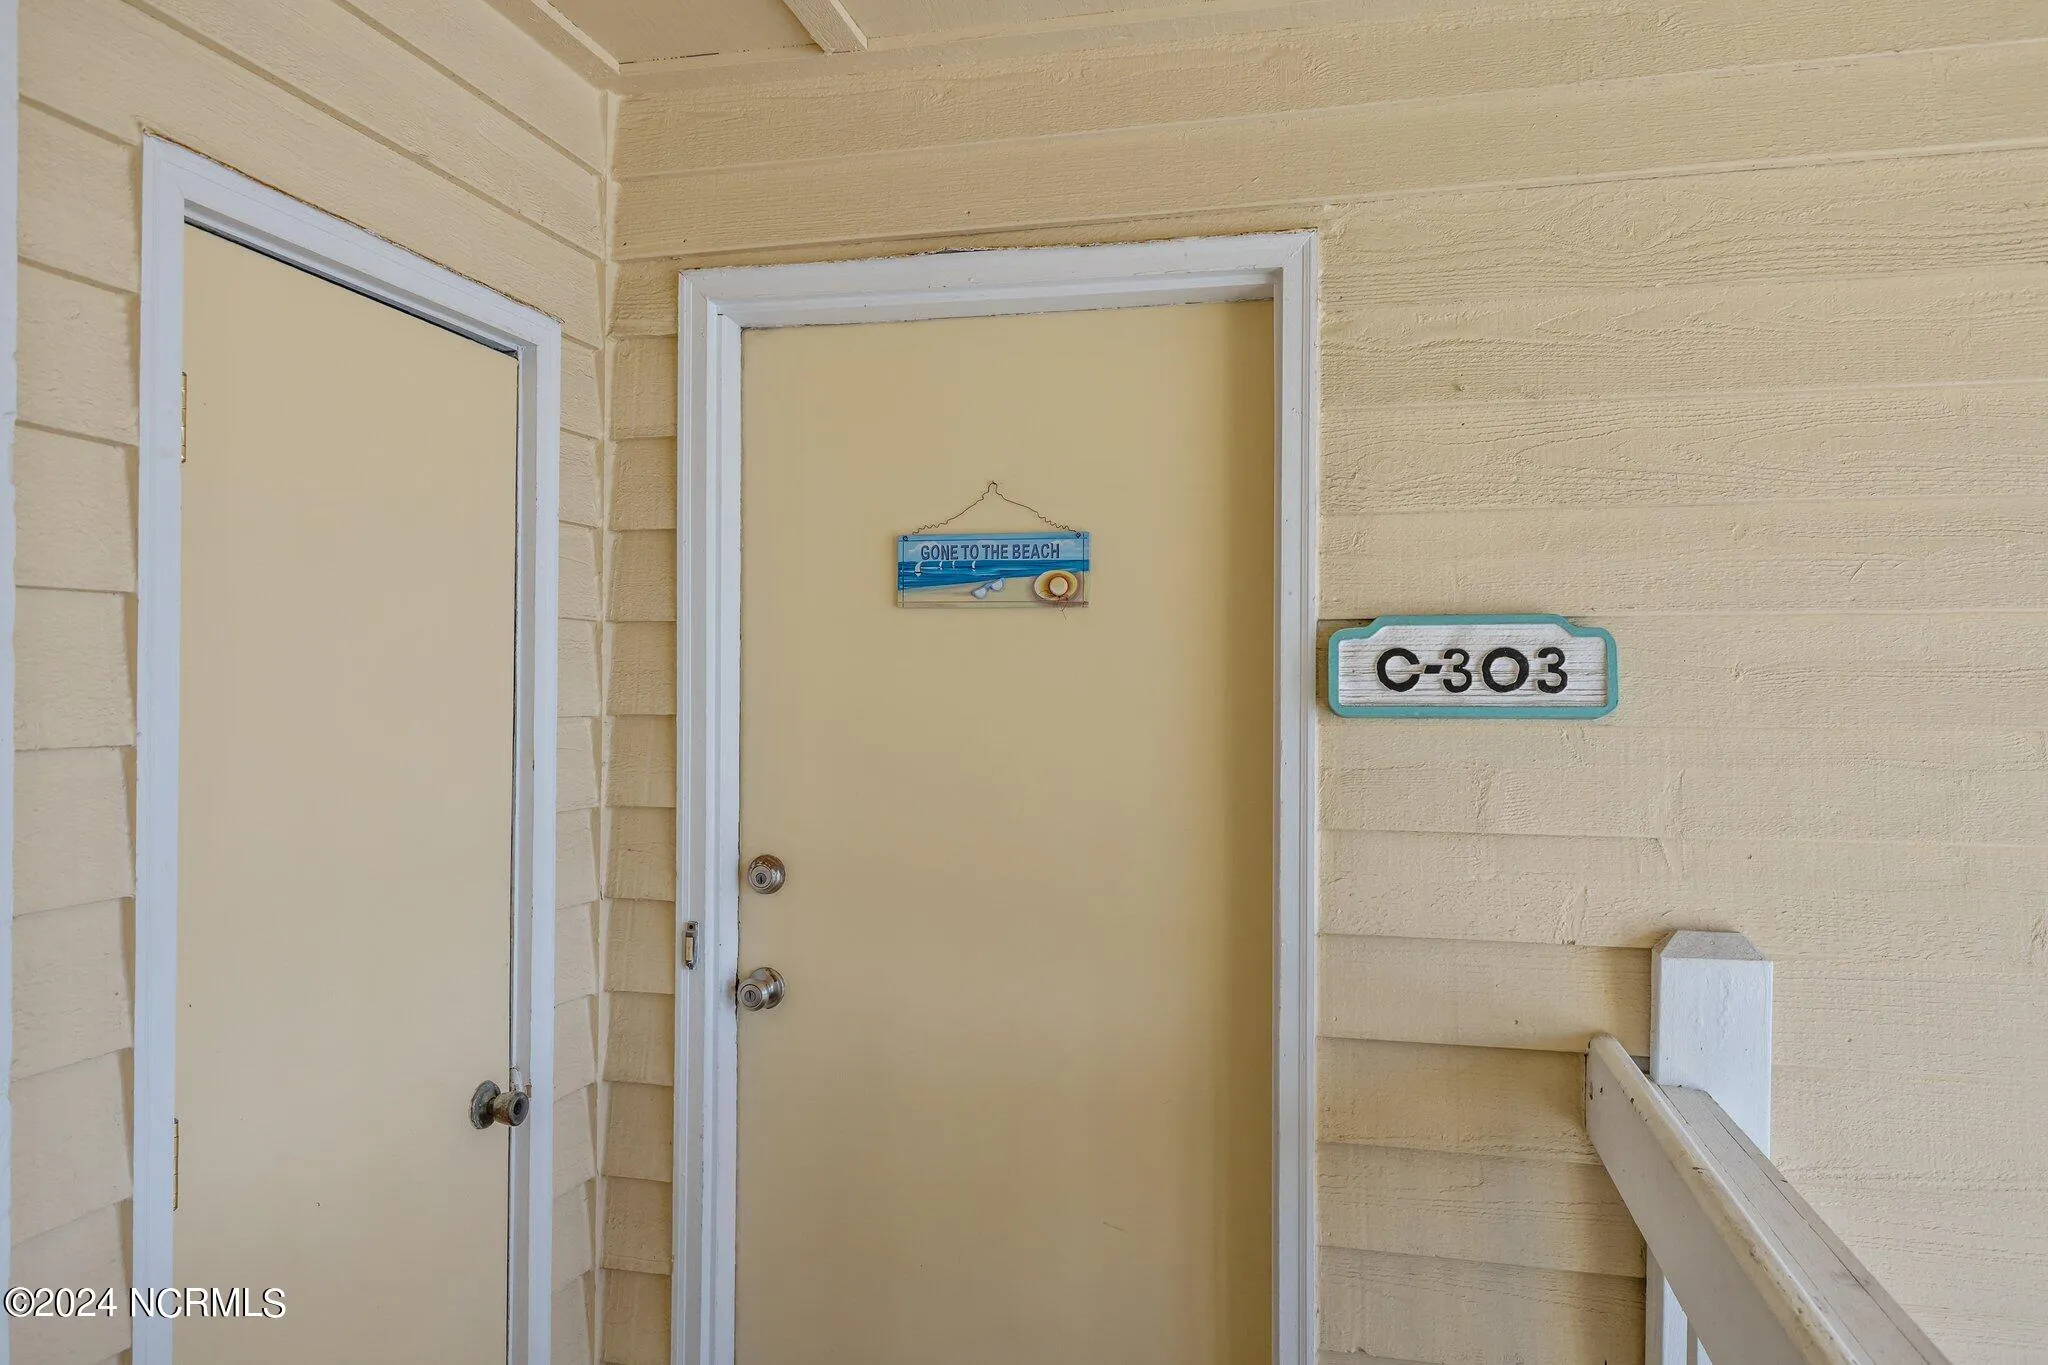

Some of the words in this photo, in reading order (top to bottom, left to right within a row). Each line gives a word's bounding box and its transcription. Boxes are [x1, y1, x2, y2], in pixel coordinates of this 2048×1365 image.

[920, 544, 959, 561] GONE
[960, 544, 979, 560] TO
[982, 543, 1009, 560] THE
[1012, 542, 1060, 560] BEACH
[1376, 646, 1568, 694] C-303
